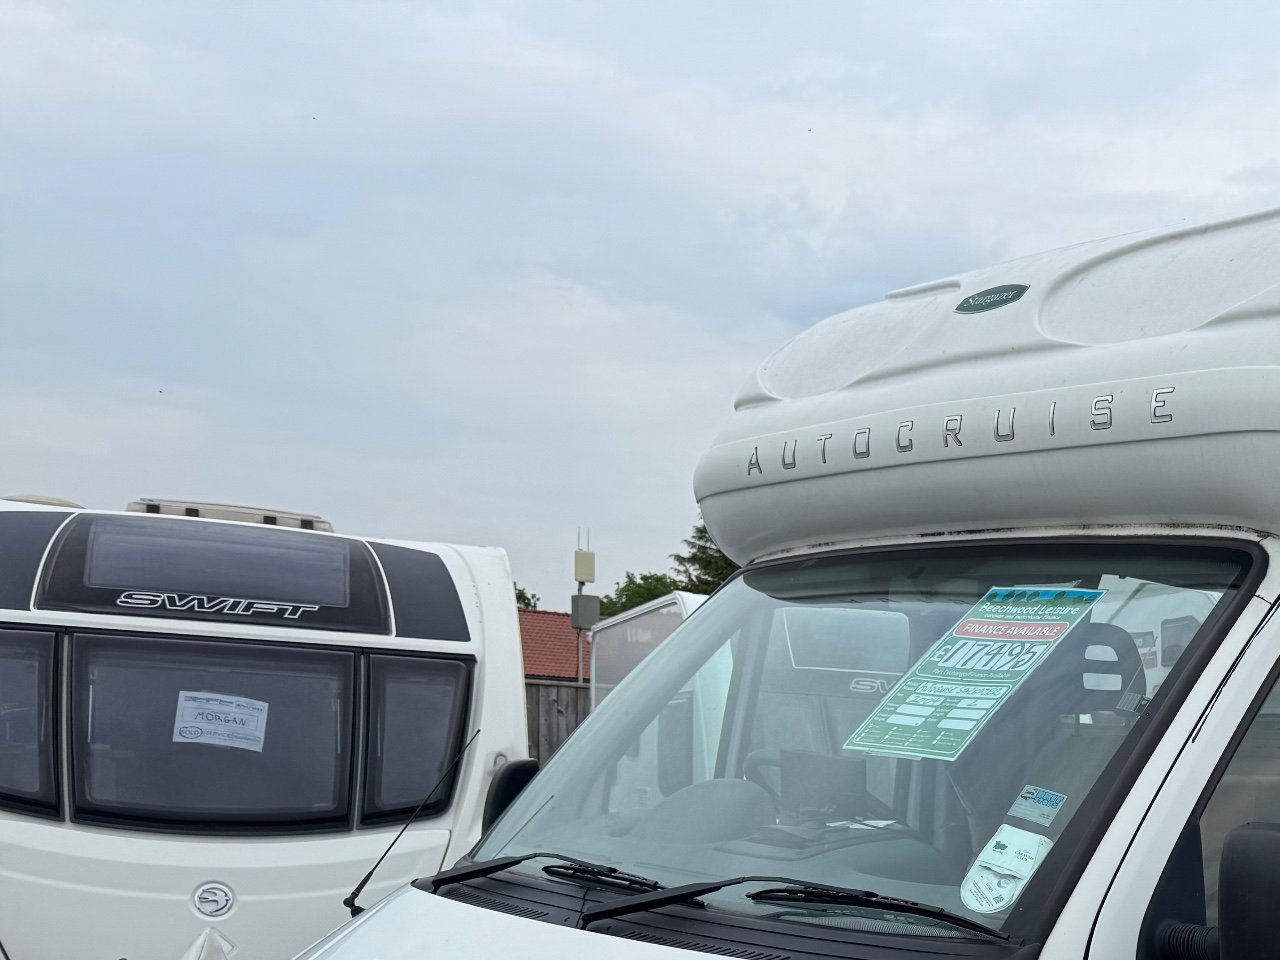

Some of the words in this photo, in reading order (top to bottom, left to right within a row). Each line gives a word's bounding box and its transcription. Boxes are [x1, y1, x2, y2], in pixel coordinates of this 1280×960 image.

[747, 387, 1175, 475] AUTOCRUISE
[117, 591, 319, 618] SWIFT
[979, 601, 1040, 615] Beechwood
[1038, 604, 1080, 615] Leisure
[962, 623, 1008, 635] FINANCE
[1006, 626, 1061, 637] AVAILABLE
[194, 711, 249, 727] MORGAN
